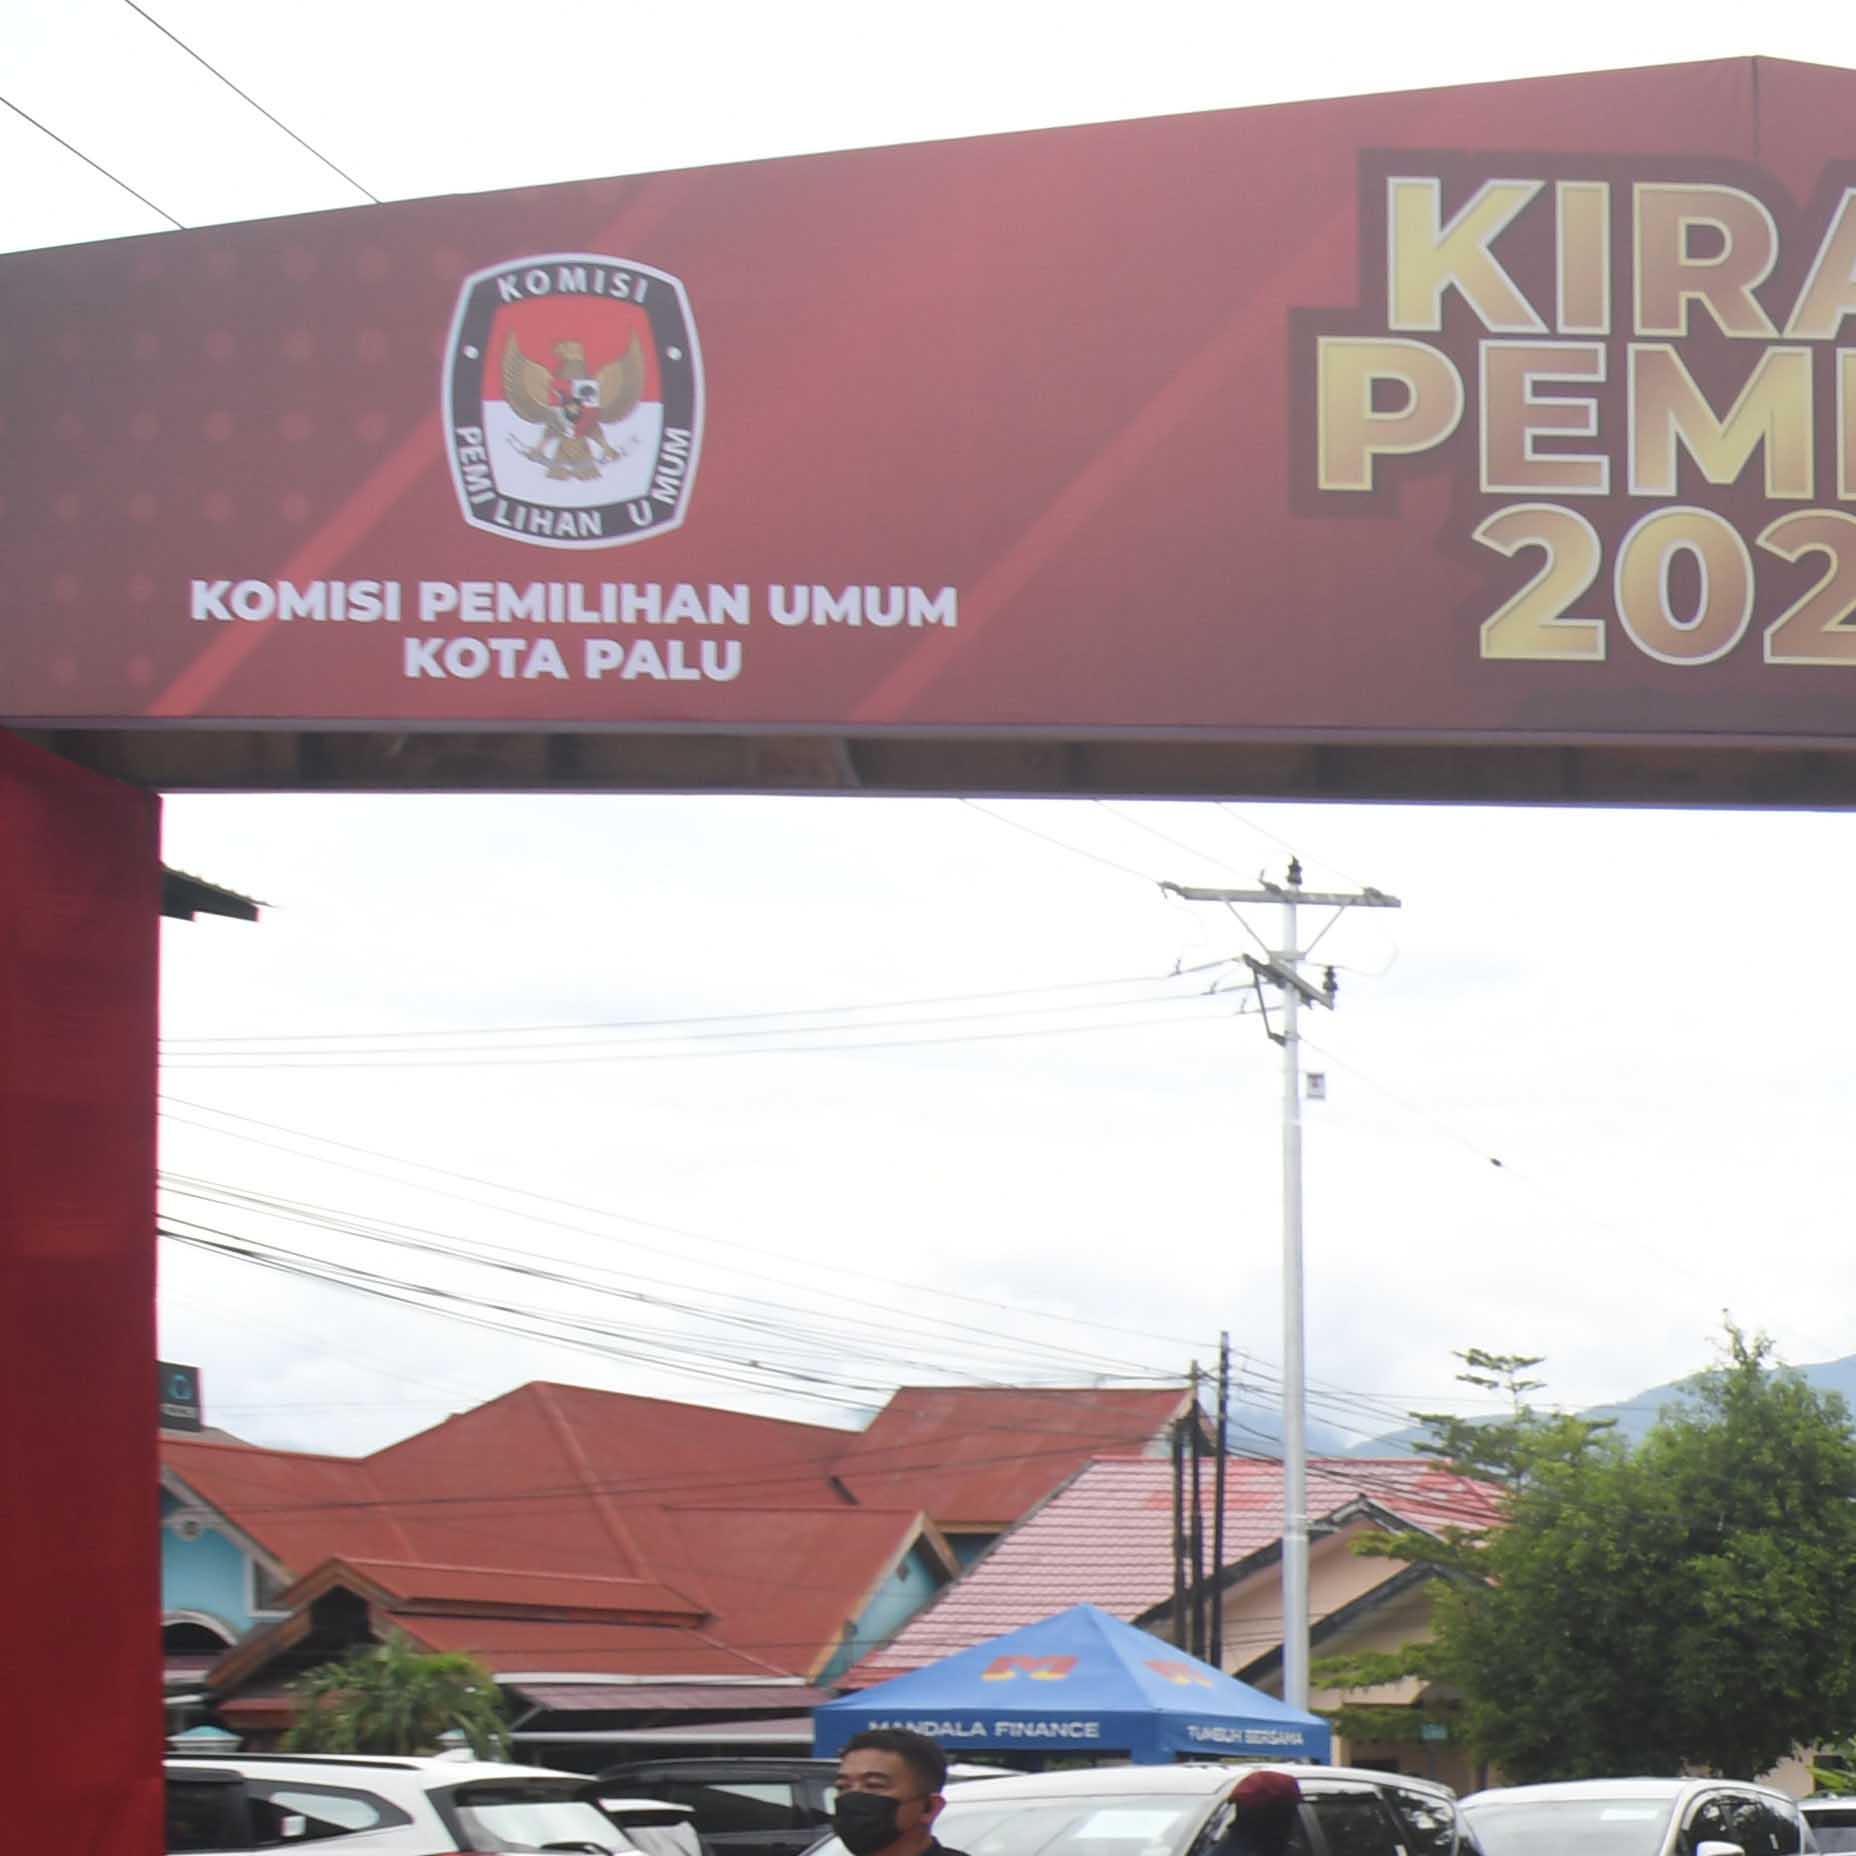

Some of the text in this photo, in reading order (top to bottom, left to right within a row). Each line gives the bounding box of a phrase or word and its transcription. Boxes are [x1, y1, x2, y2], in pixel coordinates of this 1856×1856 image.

[496, 265, 648, 303] KOMISI
[456, 426, 602, 537] PEMILIHAN
[627, 427, 691, 527] UMUM
[189, 577, 959, 628] KOMISI PEMILIHAN UMUM
[403, 636, 743, 682] KOTA PALU
[994, 1720, 1100, 1738] FINANCE
